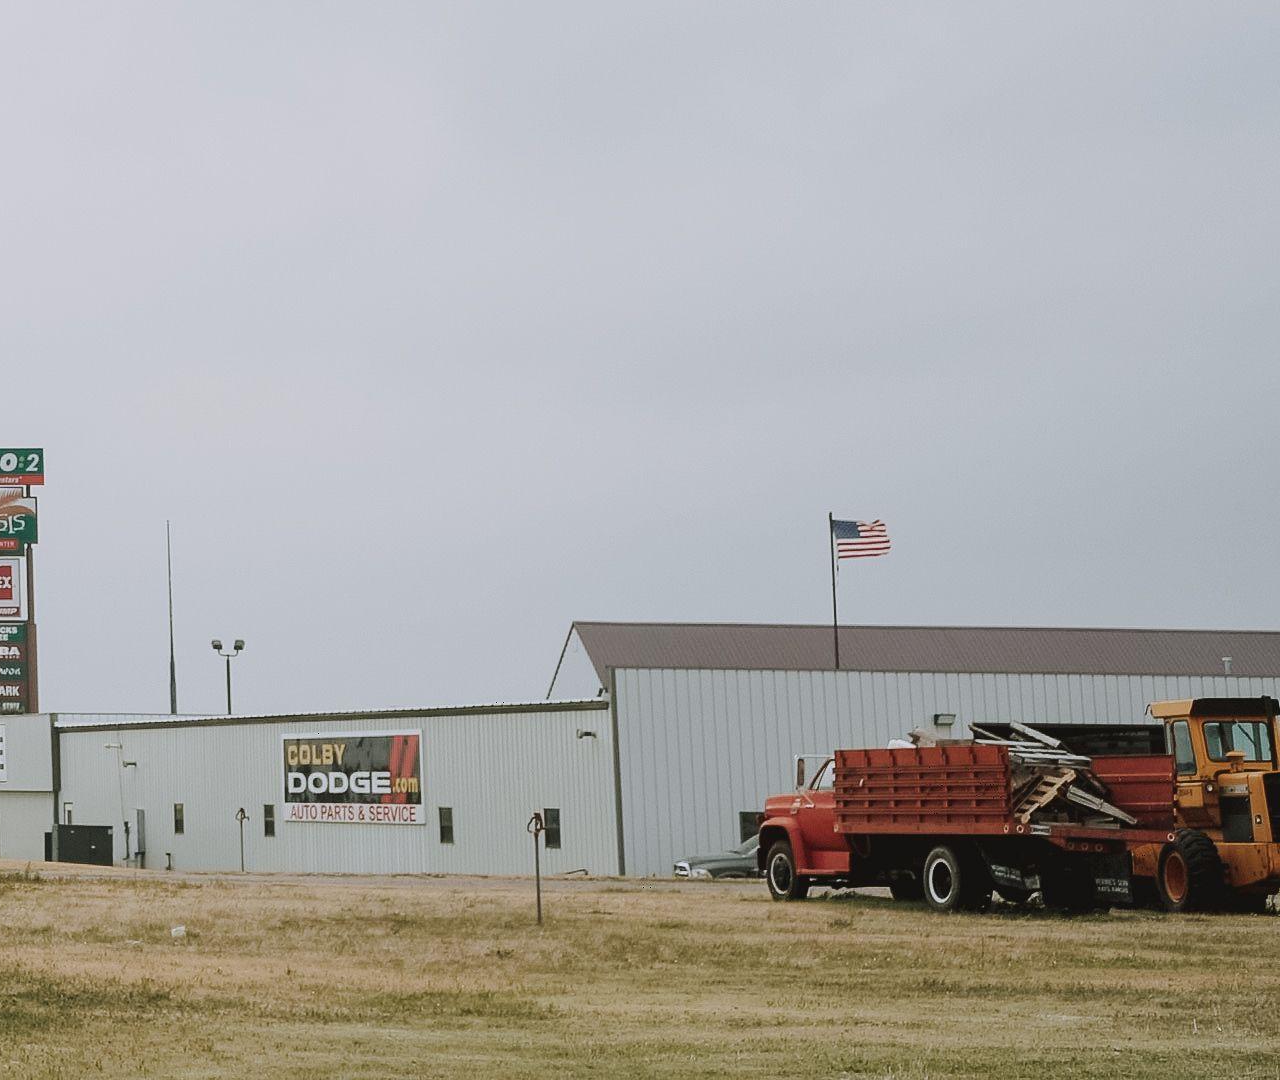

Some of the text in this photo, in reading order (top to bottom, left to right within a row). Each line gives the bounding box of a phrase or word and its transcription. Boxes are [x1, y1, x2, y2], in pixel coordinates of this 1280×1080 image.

[287, 744, 346, 766] COLBY
[291, 805, 416, 822] AUTO PARTS & SERVICE
